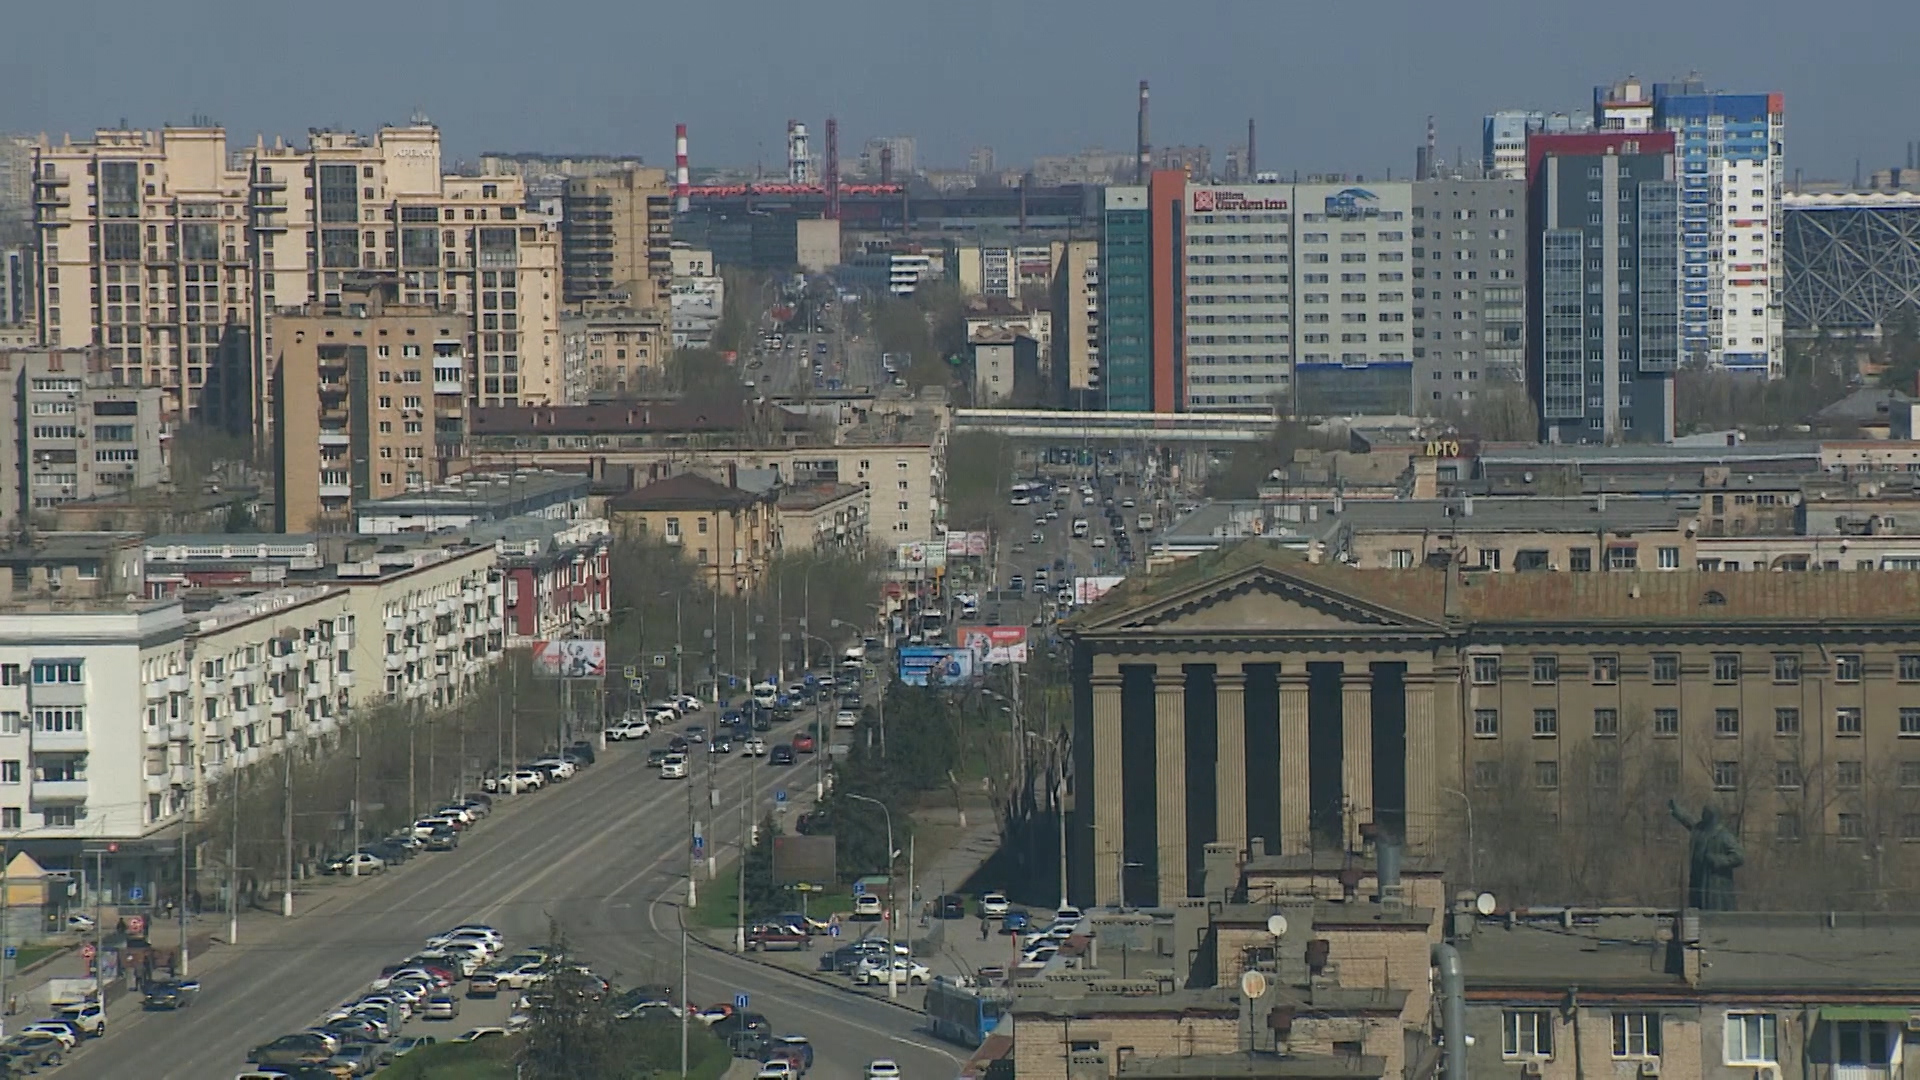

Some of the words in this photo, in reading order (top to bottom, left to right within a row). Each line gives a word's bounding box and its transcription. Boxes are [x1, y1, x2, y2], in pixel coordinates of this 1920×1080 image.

[1215, 199, 1263, 210] Garden
[1264, 198, 1288, 210] Inn
[1426, 441, 1459, 457] АРГО
